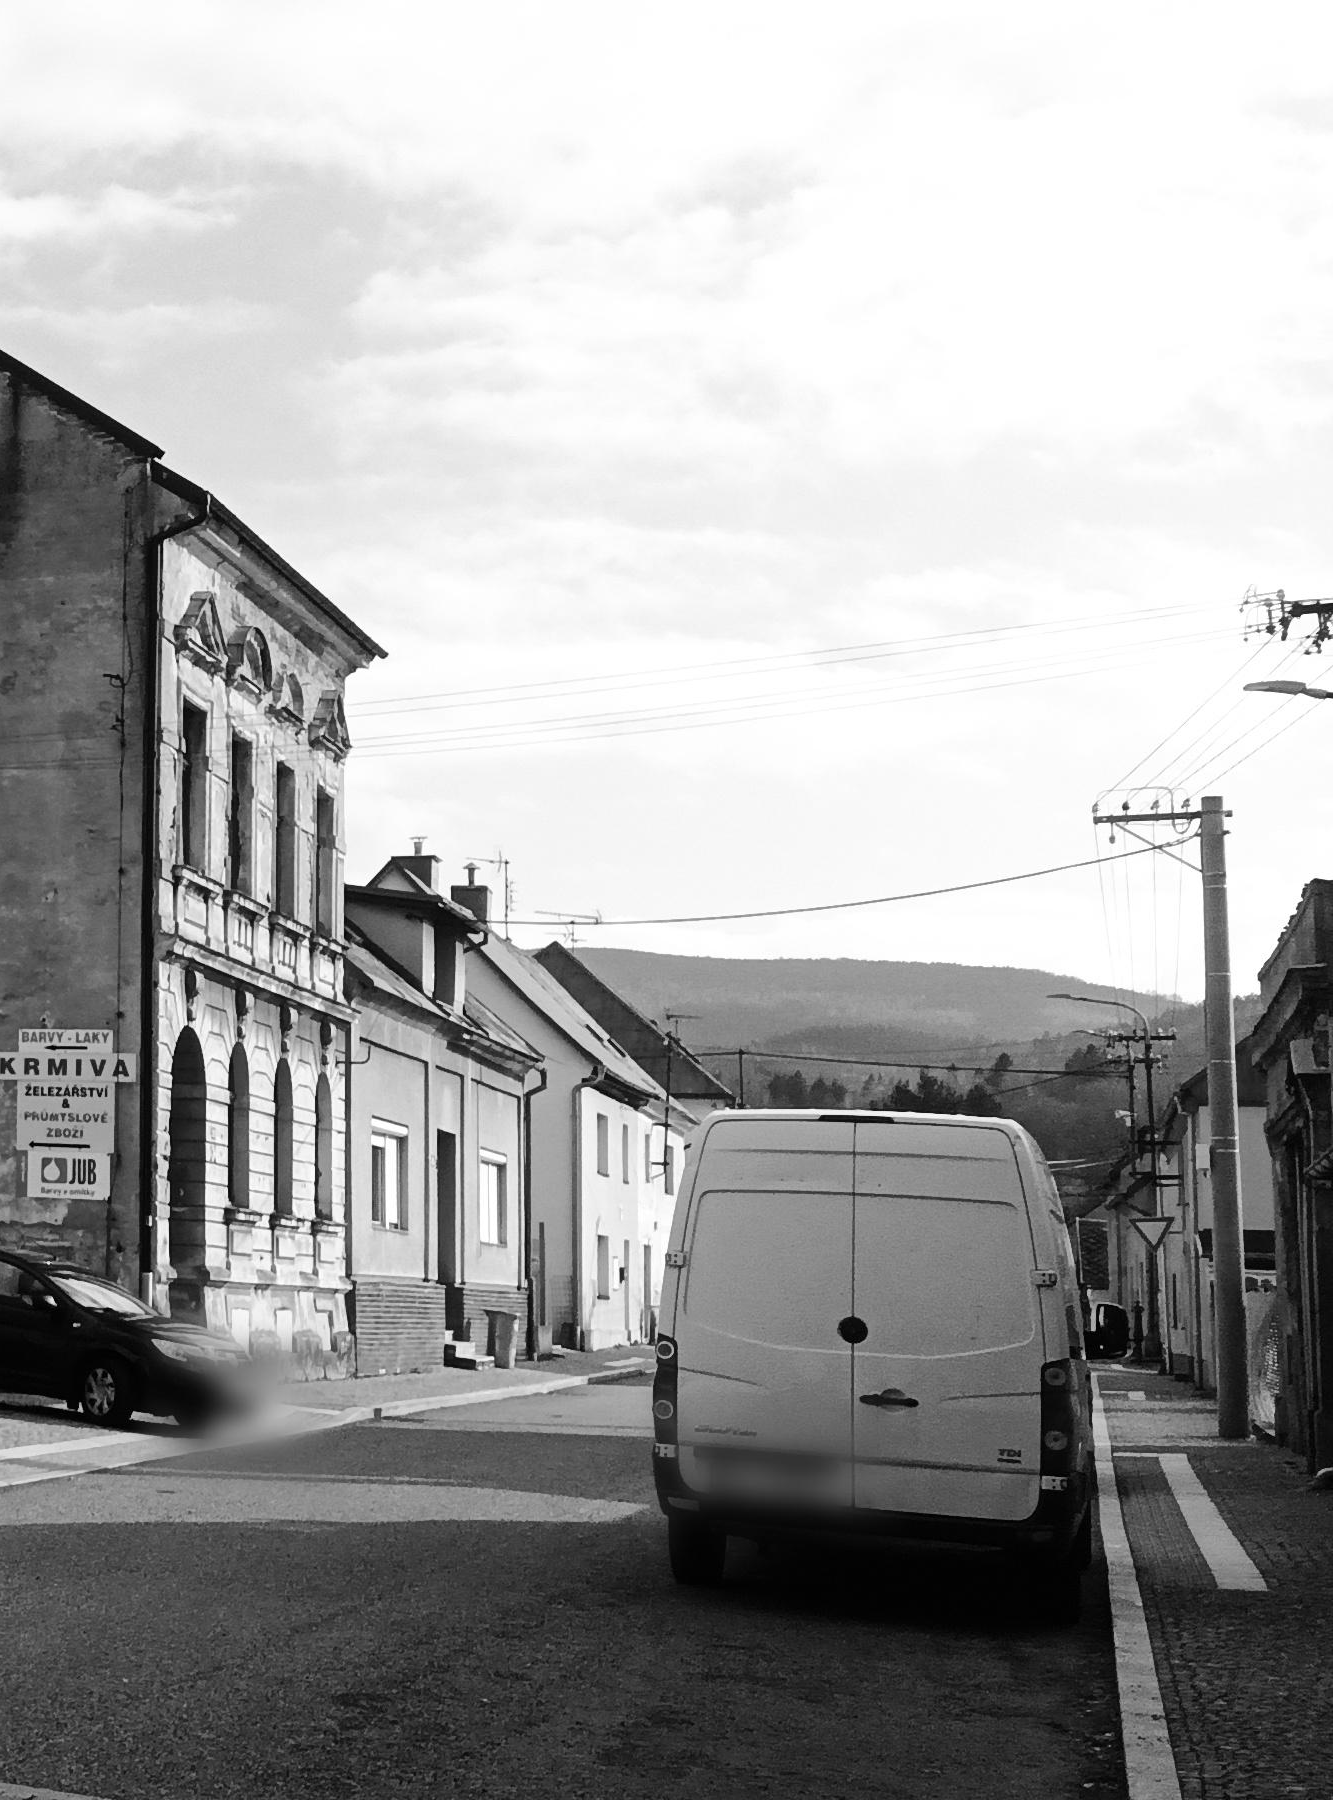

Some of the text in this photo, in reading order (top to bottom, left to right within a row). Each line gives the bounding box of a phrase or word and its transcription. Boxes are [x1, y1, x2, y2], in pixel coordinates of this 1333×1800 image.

[21, 1031, 65, 1044] BARVY
[75, 1031, 110, 1044] LAKY
[0, 1057, 130, 1077] KRMIVA
[24, 1083, 109, 1098] ŽELEZÁŘSTVÍ
[61, 1098, 71, 1109] &
[68, 1158, 98, 1185] JUB
